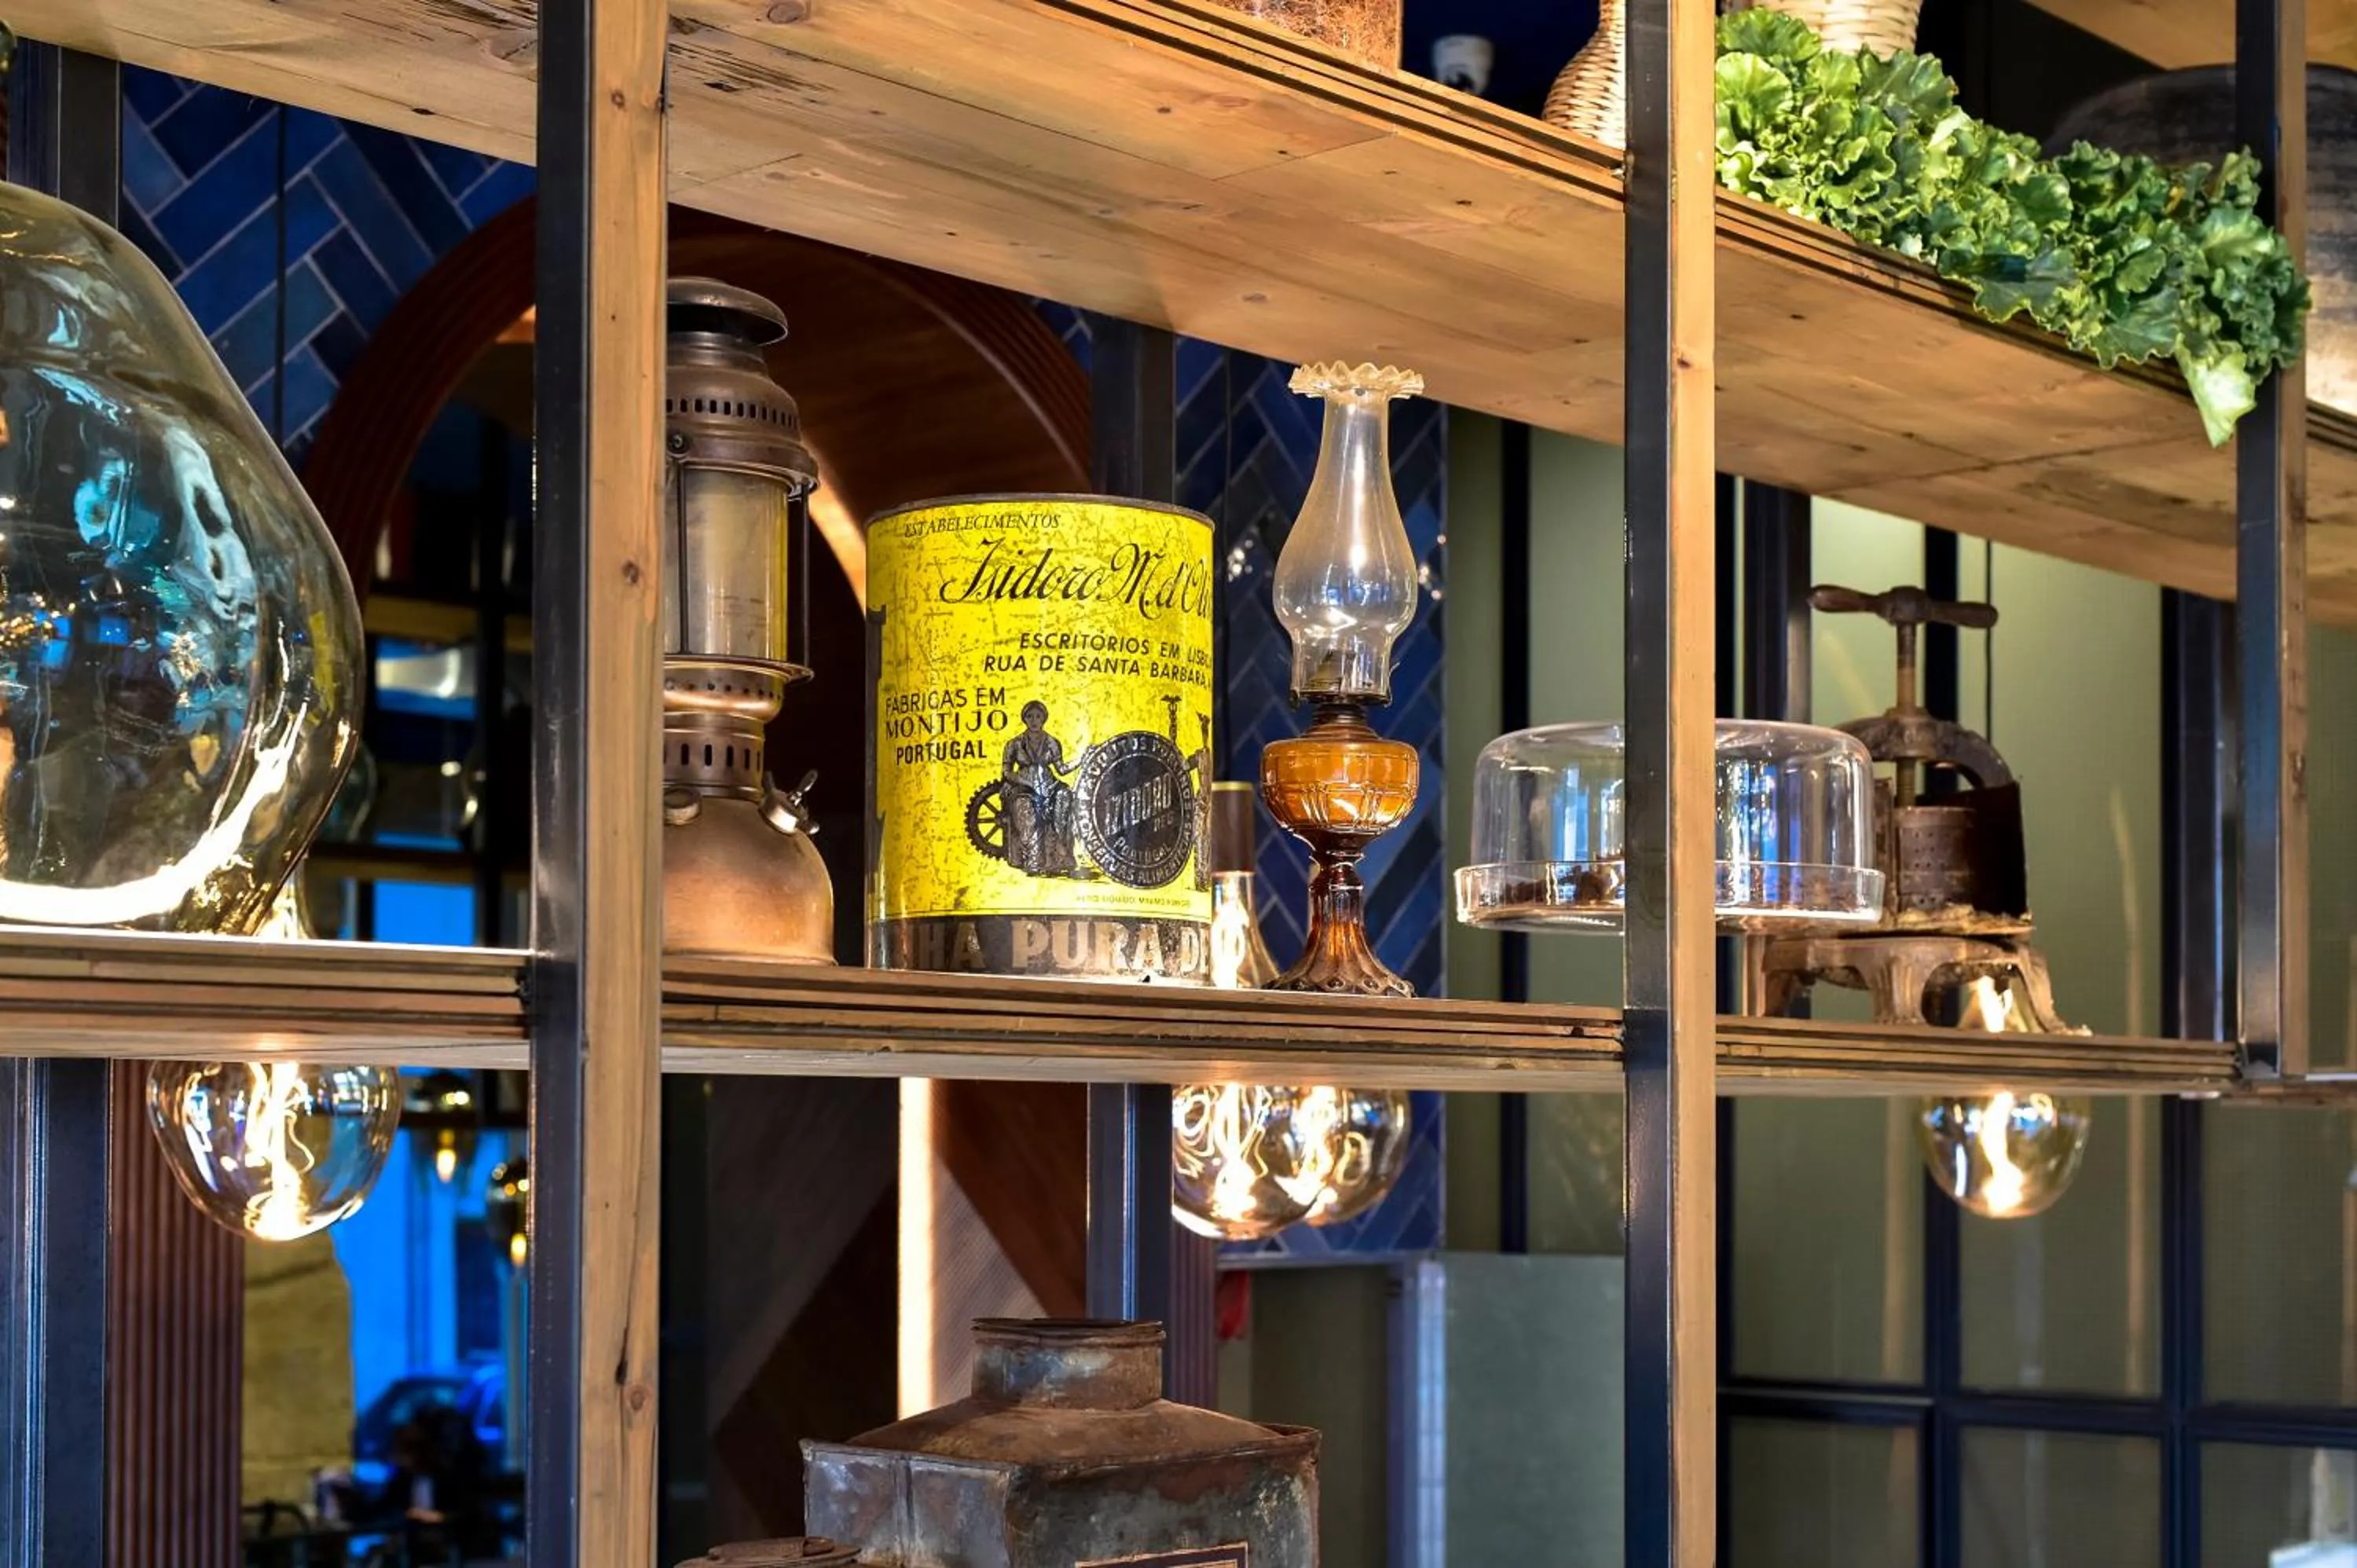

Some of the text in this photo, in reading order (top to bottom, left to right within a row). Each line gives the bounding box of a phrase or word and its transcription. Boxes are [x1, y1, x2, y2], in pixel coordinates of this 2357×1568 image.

[904, 514, 1061, 538] ESTABELECIMENTOS
[1160, 641, 1180, 660] EM
[984, 655, 1027, 673] RUA
[1039, 654, 1065, 672] DE
[1077, 656, 1140, 676] SANTA
[977, 687, 1005, 707] EM
[885, 709, 1009, 741] MONTIJO
[896, 739, 988, 766] PORTUGAL
[1112, 836, 1173, 864] PORTUGAL
[1011, 920, 1164, 973] PURA
